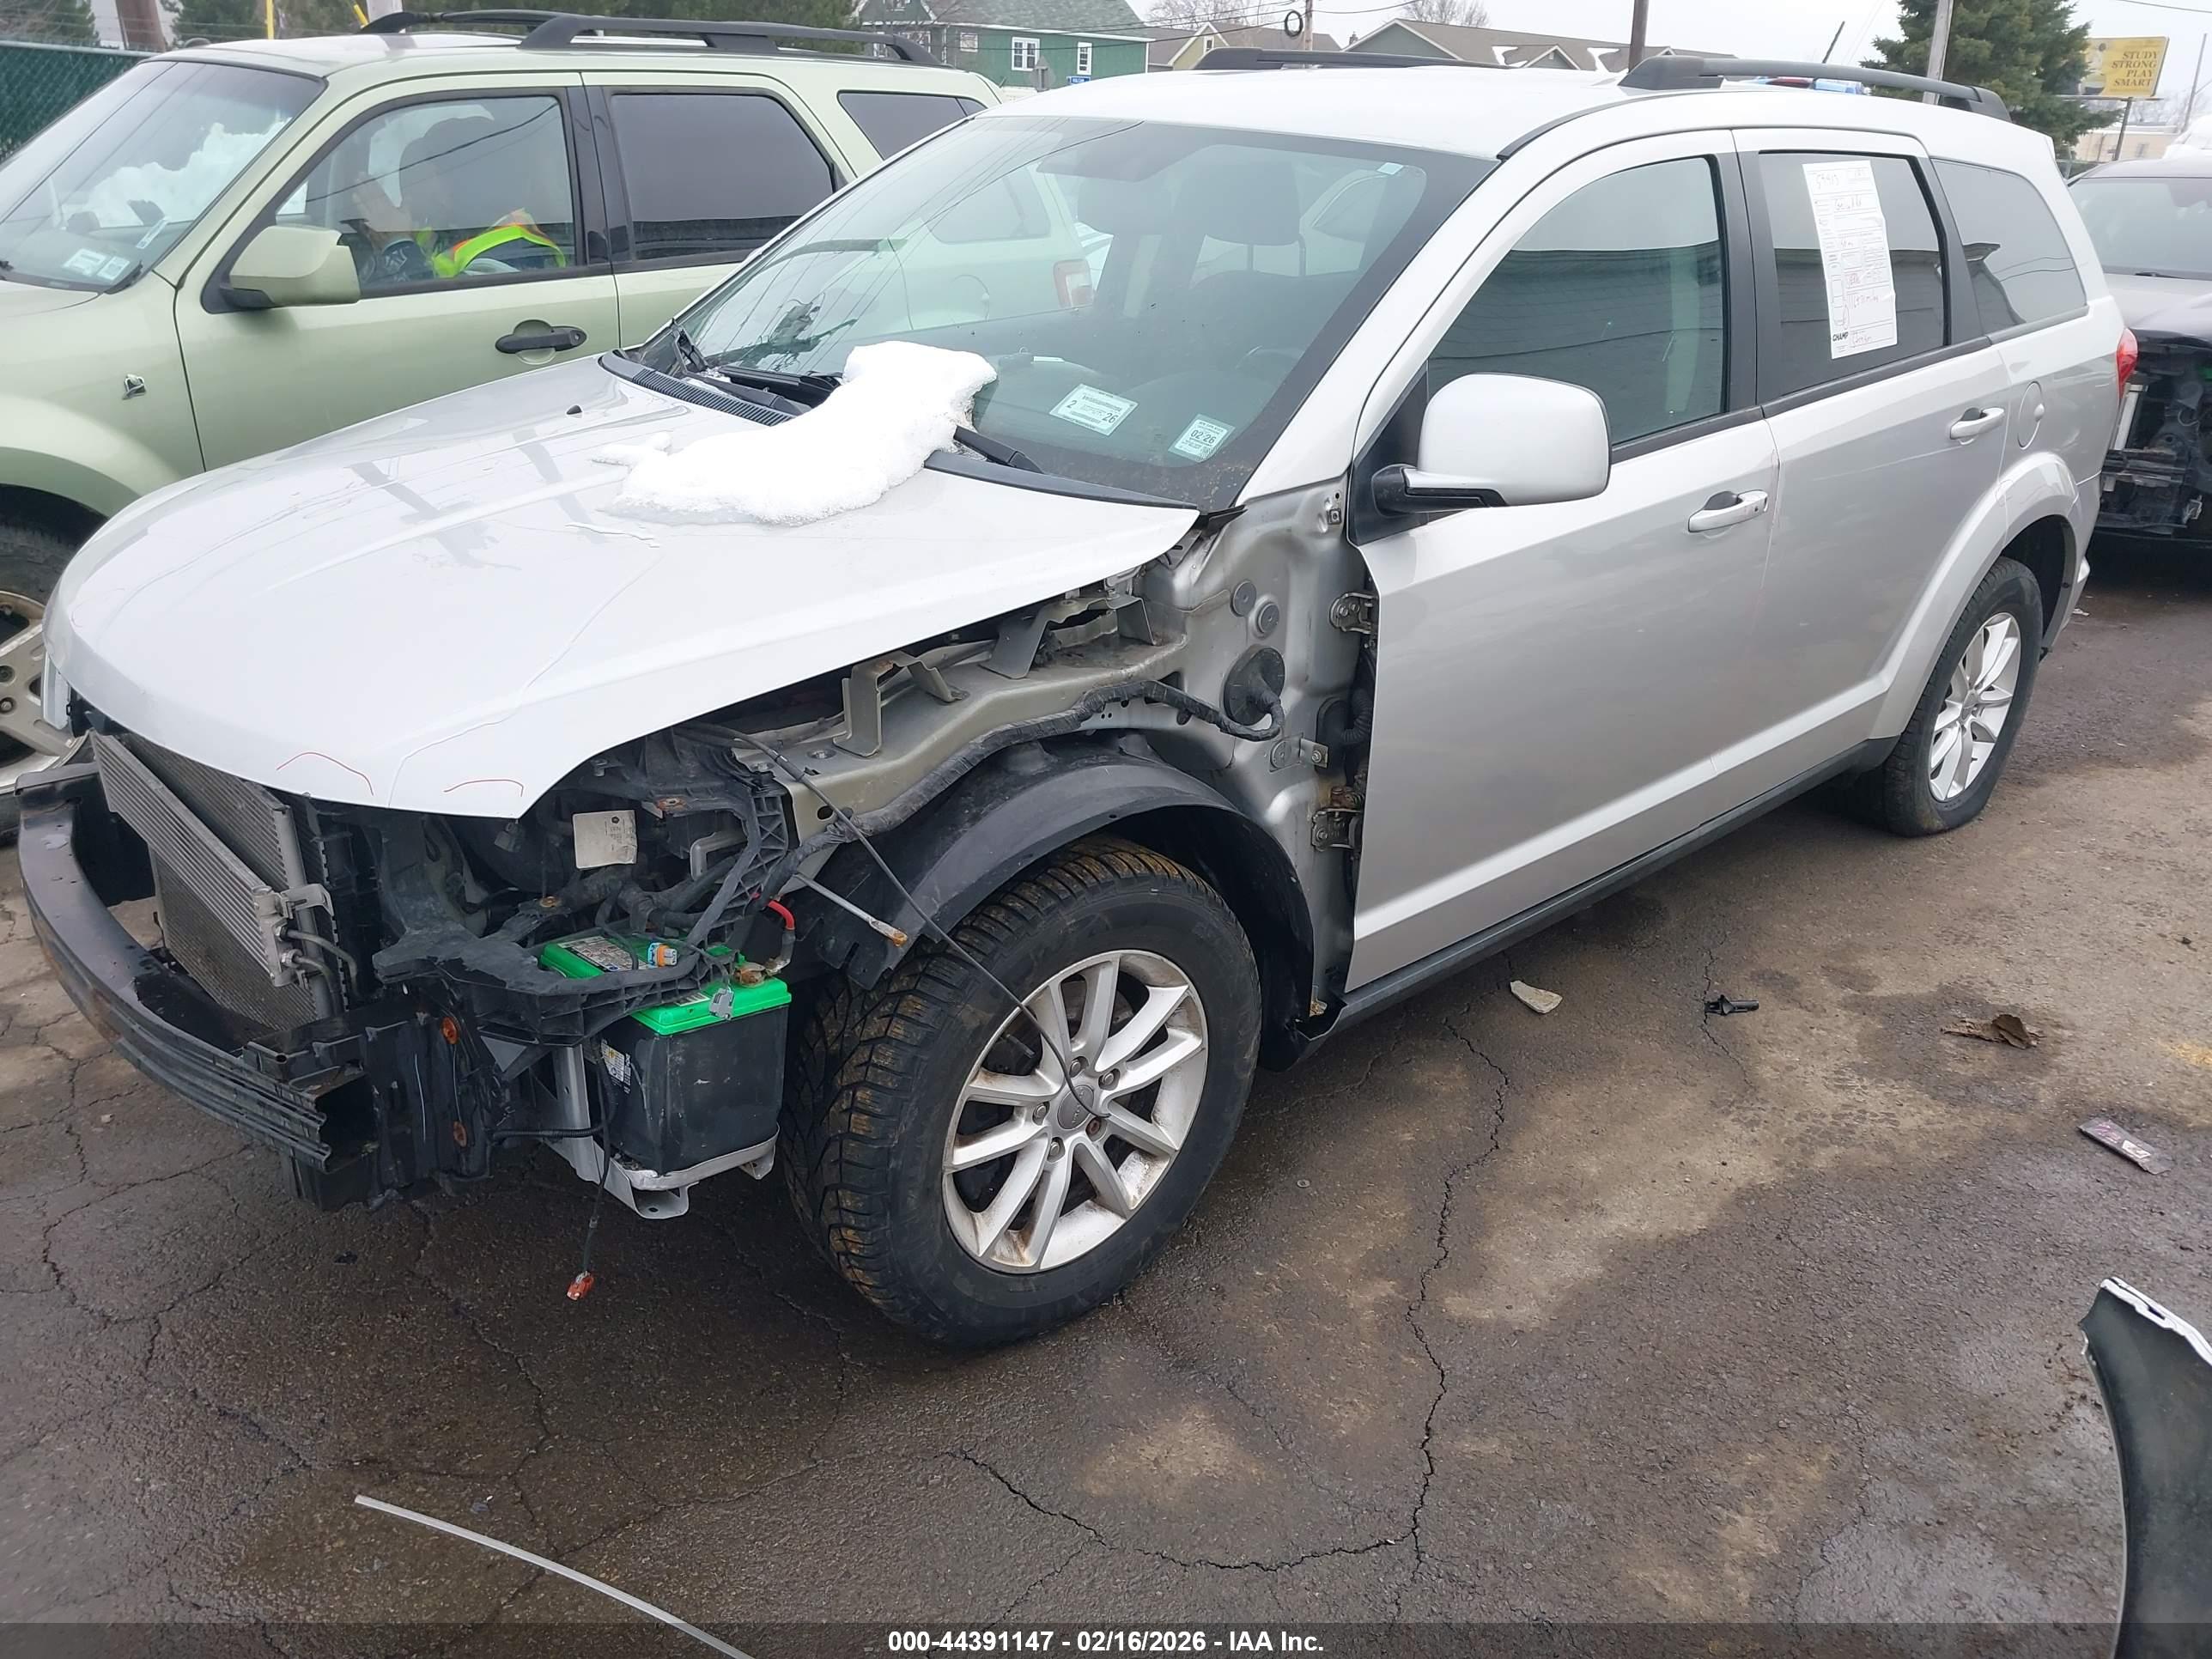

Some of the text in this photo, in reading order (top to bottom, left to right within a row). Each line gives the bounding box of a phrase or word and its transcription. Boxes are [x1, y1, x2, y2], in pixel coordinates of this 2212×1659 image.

[2123, 51, 2157, 59] STUDY
[2112, 60, 2157, 69] STRONG
[2114, 78, 2152, 87] SMART
[1832, 332, 1849, 342] CHAMP
[1102, 412, 1118, 424] 26
